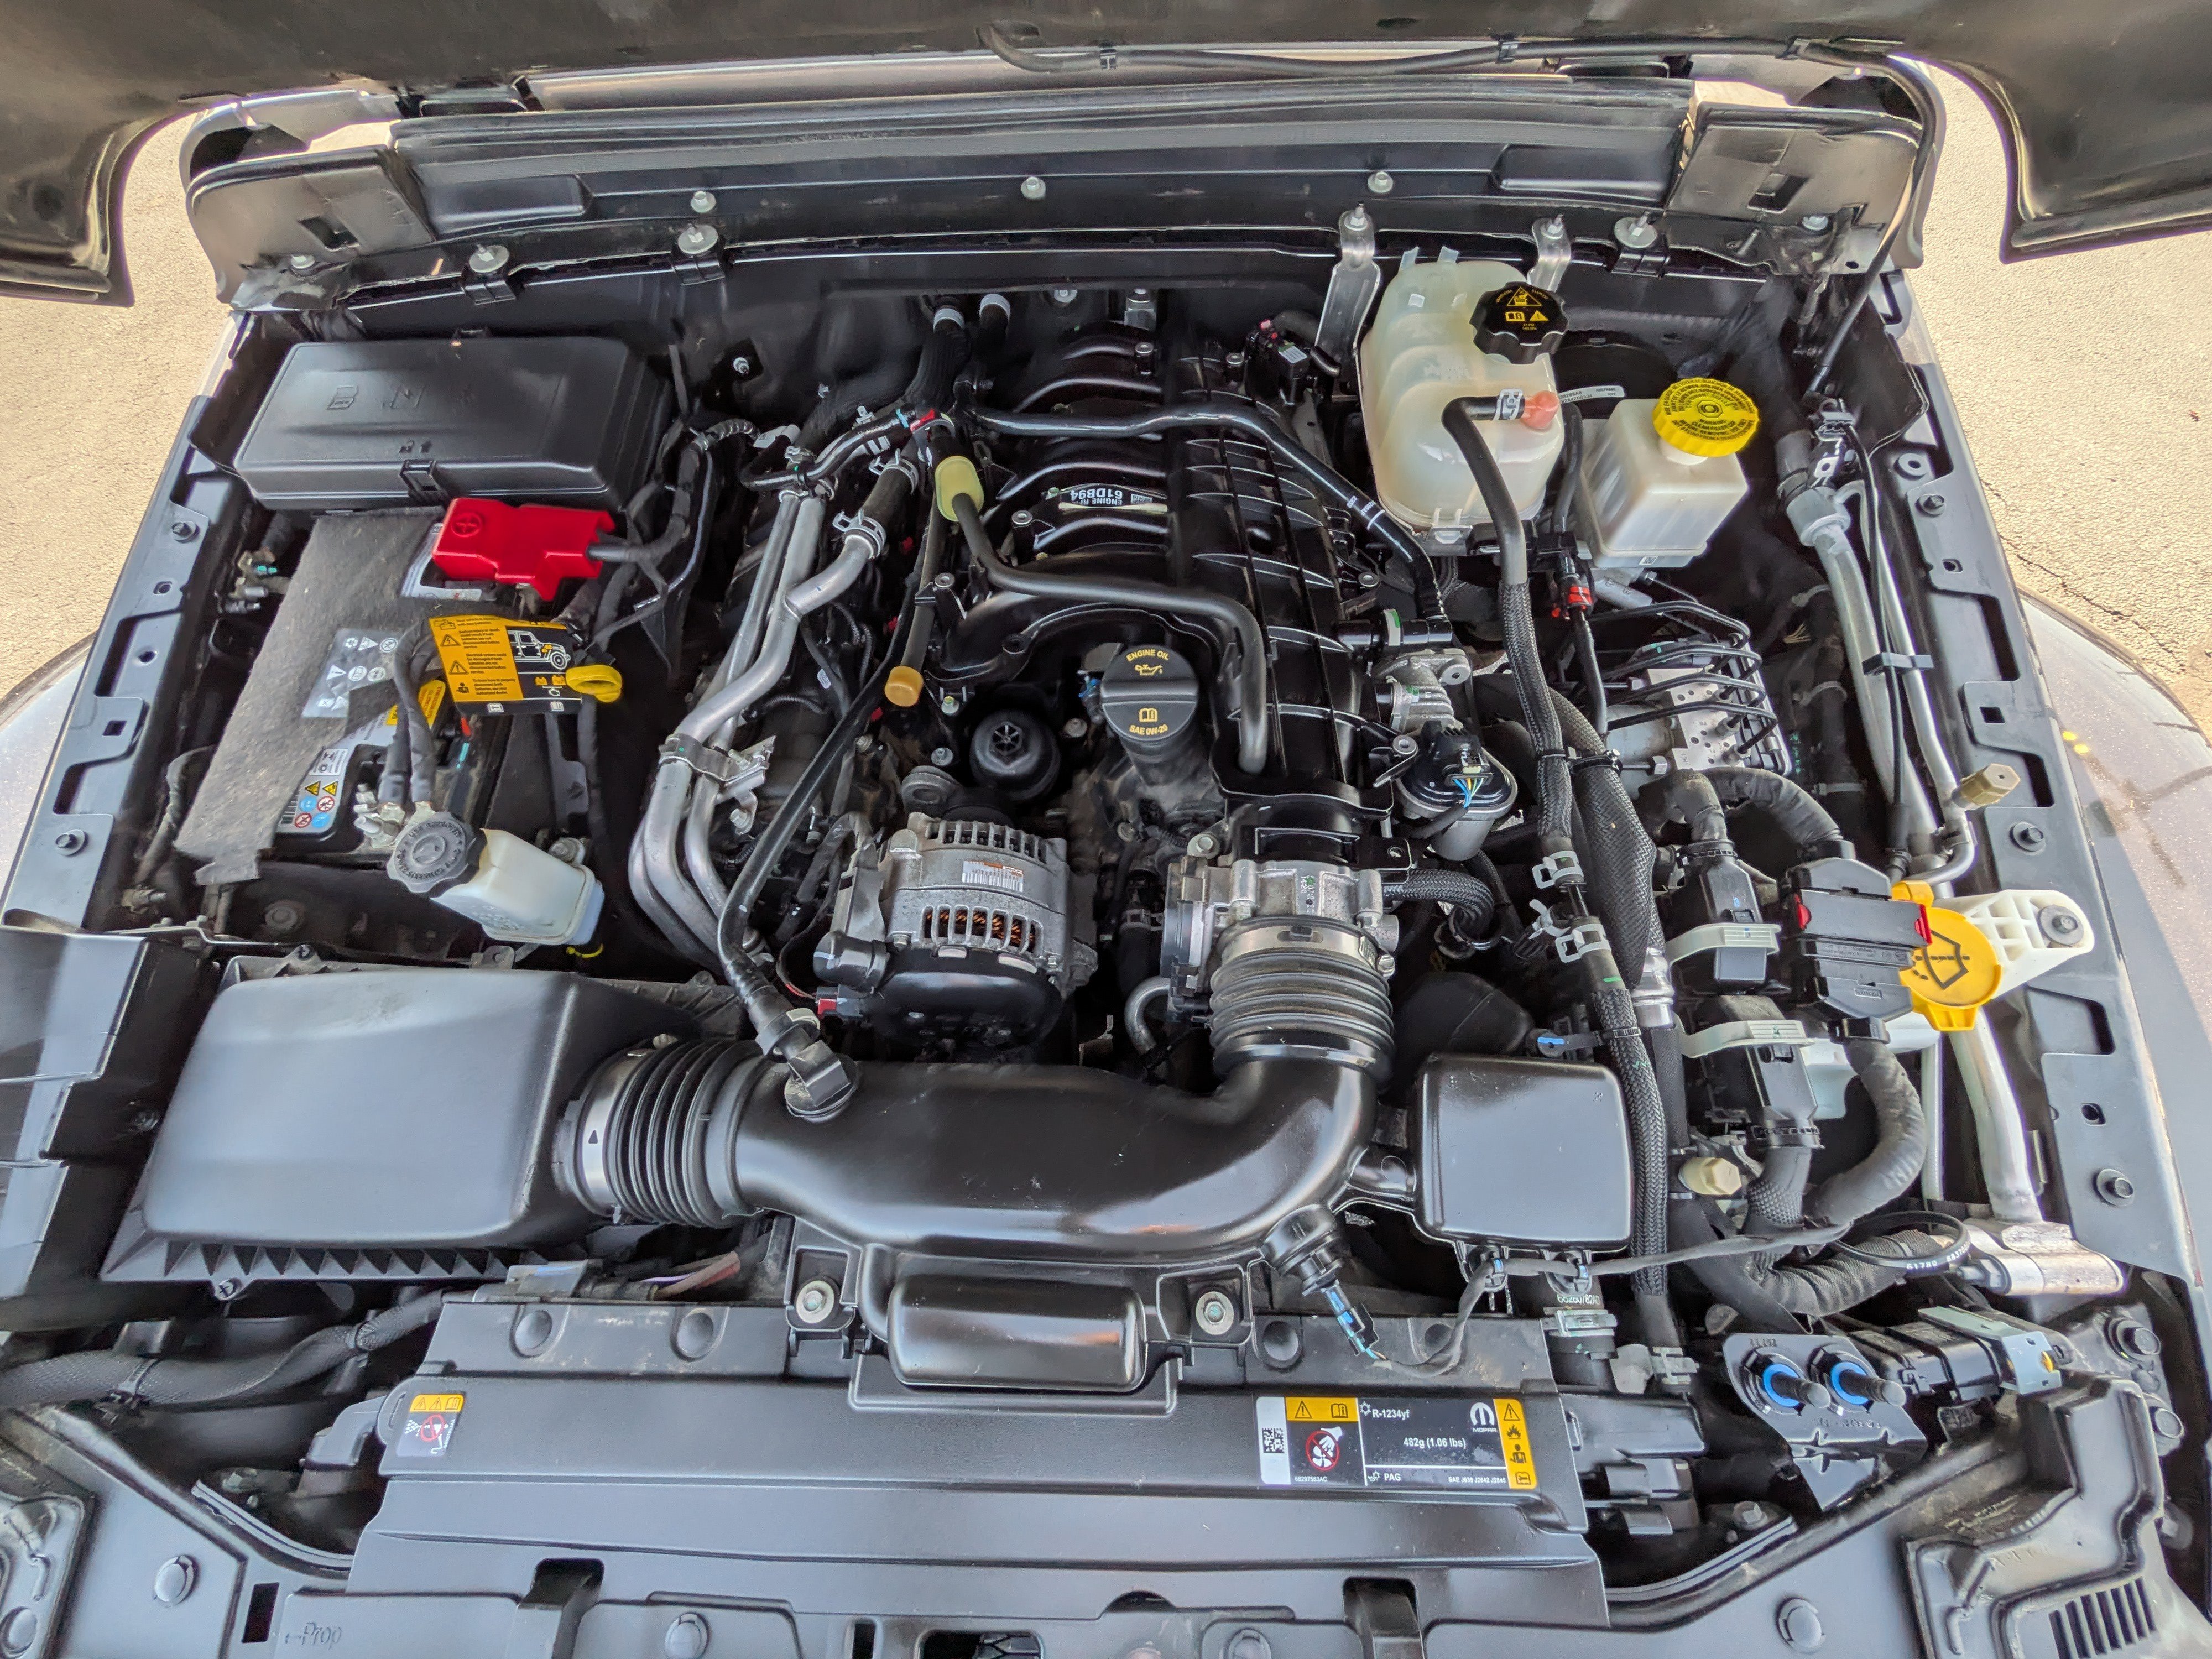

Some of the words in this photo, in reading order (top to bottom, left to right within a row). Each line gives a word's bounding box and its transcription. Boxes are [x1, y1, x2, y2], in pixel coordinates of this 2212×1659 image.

[1070, 488, 1123, 502] 61DB94
[1126, 649, 1156, 662] ENGINE
[1157, 650, 1170, 661] OIL
[1129, 724, 1145, 735] SAE
[1146, 724, 1168, 735] 0W-20
[1372, 1408, 1410, 1420] R-1234yf
[1404, 1437, 1425, 1449] 482g
[1426, 1438, 1447, 1449] (1.06
[1449, 1438, 1467, 1449] lbs)
[1384, 1473, 1401, 1481] PAG
